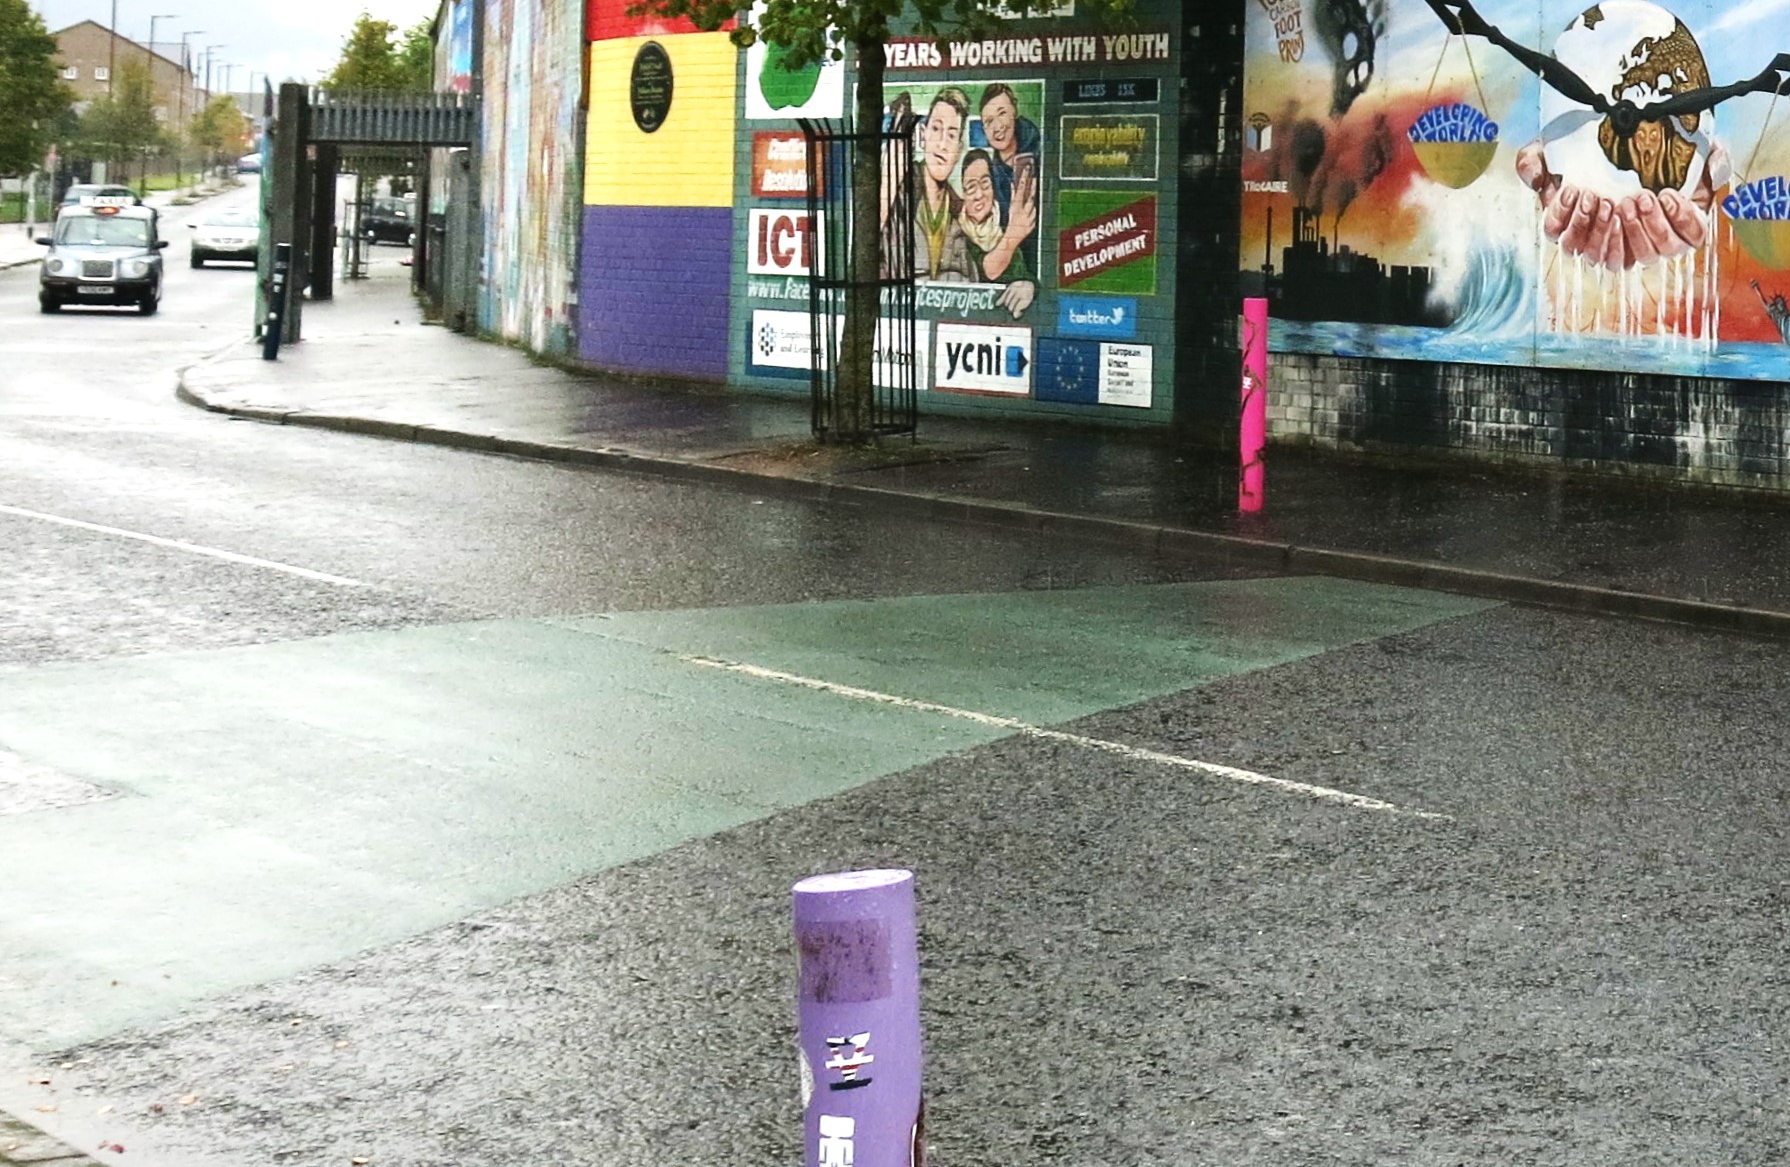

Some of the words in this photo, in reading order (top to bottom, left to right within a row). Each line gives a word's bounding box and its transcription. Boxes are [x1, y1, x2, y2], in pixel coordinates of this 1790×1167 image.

[1275, 10, 1302, 38] FOOT
[883, 41, 942, 68] YEARS
[950, 38, 1042, 68] WORKING
[1047, 36, 1096, 62] WITH
[1102, 33, 1169, 61] YOUTH
[1406, 101, 1500, 143] DEVELOPING
[1422, 123, 1483, 143] WORLD
[757, 214, 816, 268] ICT
[1074, 213, 1137, 250] PERSONAL
[1063, 234, 1147, 277] DEVELOPMENT
[1069, 308, 1111, 325] twitter
[946, 336, 1001, 381] ycni
